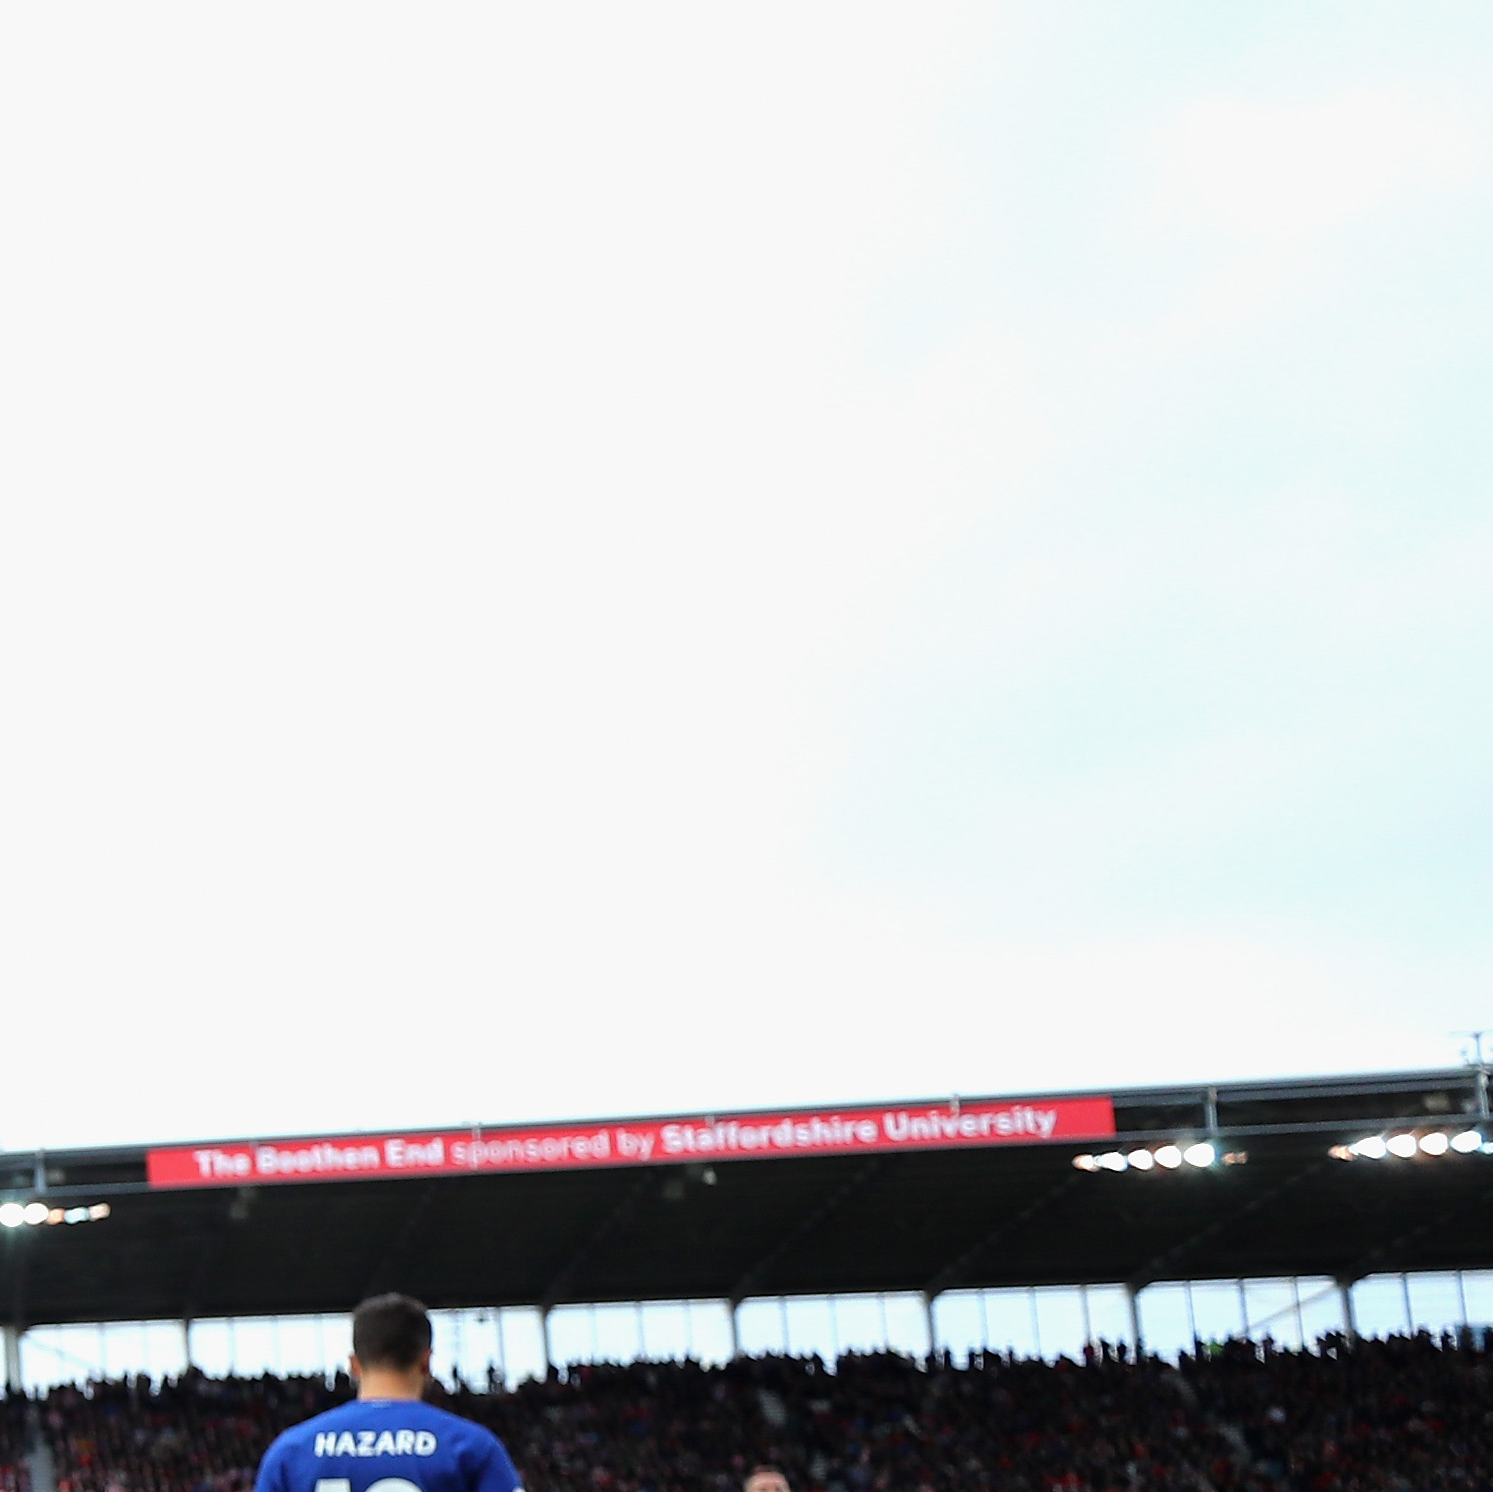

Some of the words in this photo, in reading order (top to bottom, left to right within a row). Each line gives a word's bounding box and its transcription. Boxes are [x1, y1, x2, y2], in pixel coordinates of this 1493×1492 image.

[193, 1149, 252, 1178] The
[256, 1145, 380, 1175] Boothen
[384, 1136, 445, 1168] End
[451, 1129, 611, 1170] sponsored
[617, 1127, 655, 1161] by
[660, 1115, 879, 1153] Staffordshire
[883, 1105, 1057, 1140] University
[314, 1429, 438, 1458] HAZARD
